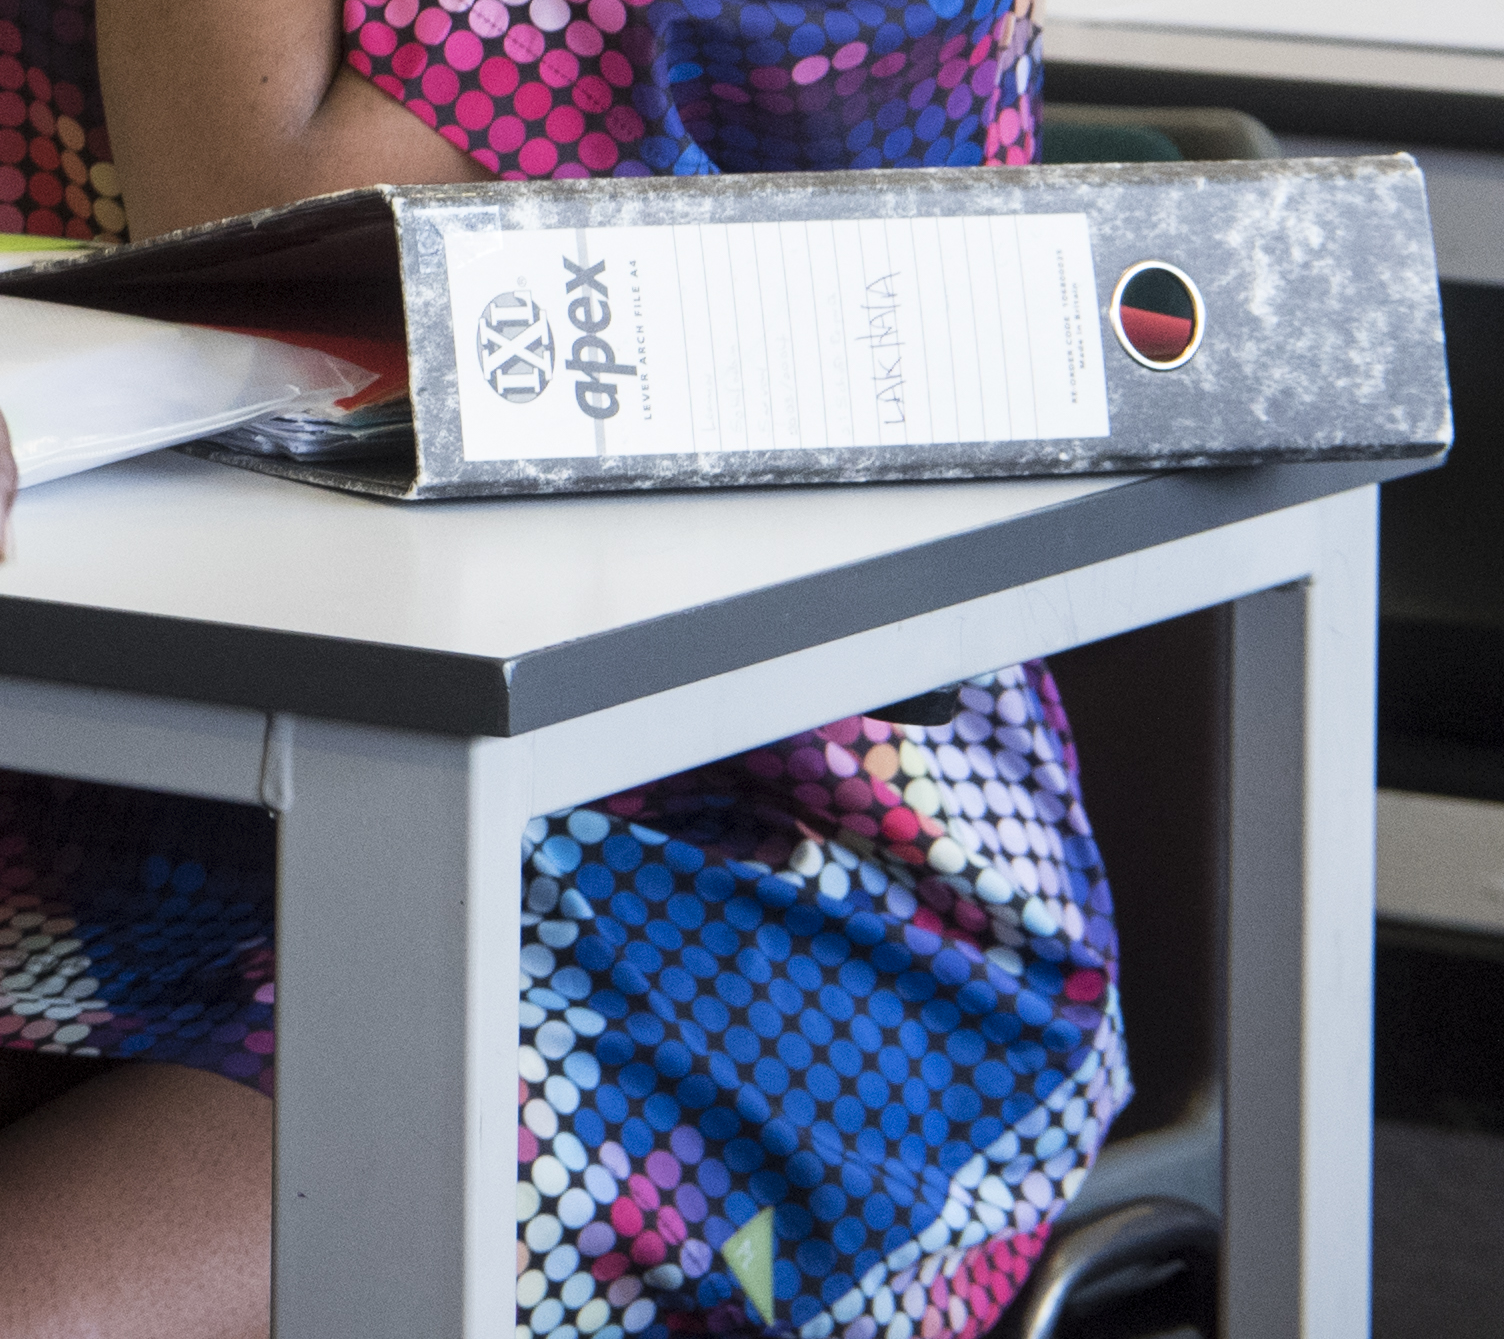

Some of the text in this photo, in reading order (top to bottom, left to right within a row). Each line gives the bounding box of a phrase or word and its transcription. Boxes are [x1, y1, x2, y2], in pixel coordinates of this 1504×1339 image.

[1063, 316, 1073, 346] CODE
[1071, 282, 1081, 320] Britain
[479, 290, 553, 394] IXL
[561, 255, 638, 420] apex
[628, 258, 653, 421] LEVER ARCH FILE A4
[1077, 339, 1086, 369] Made
